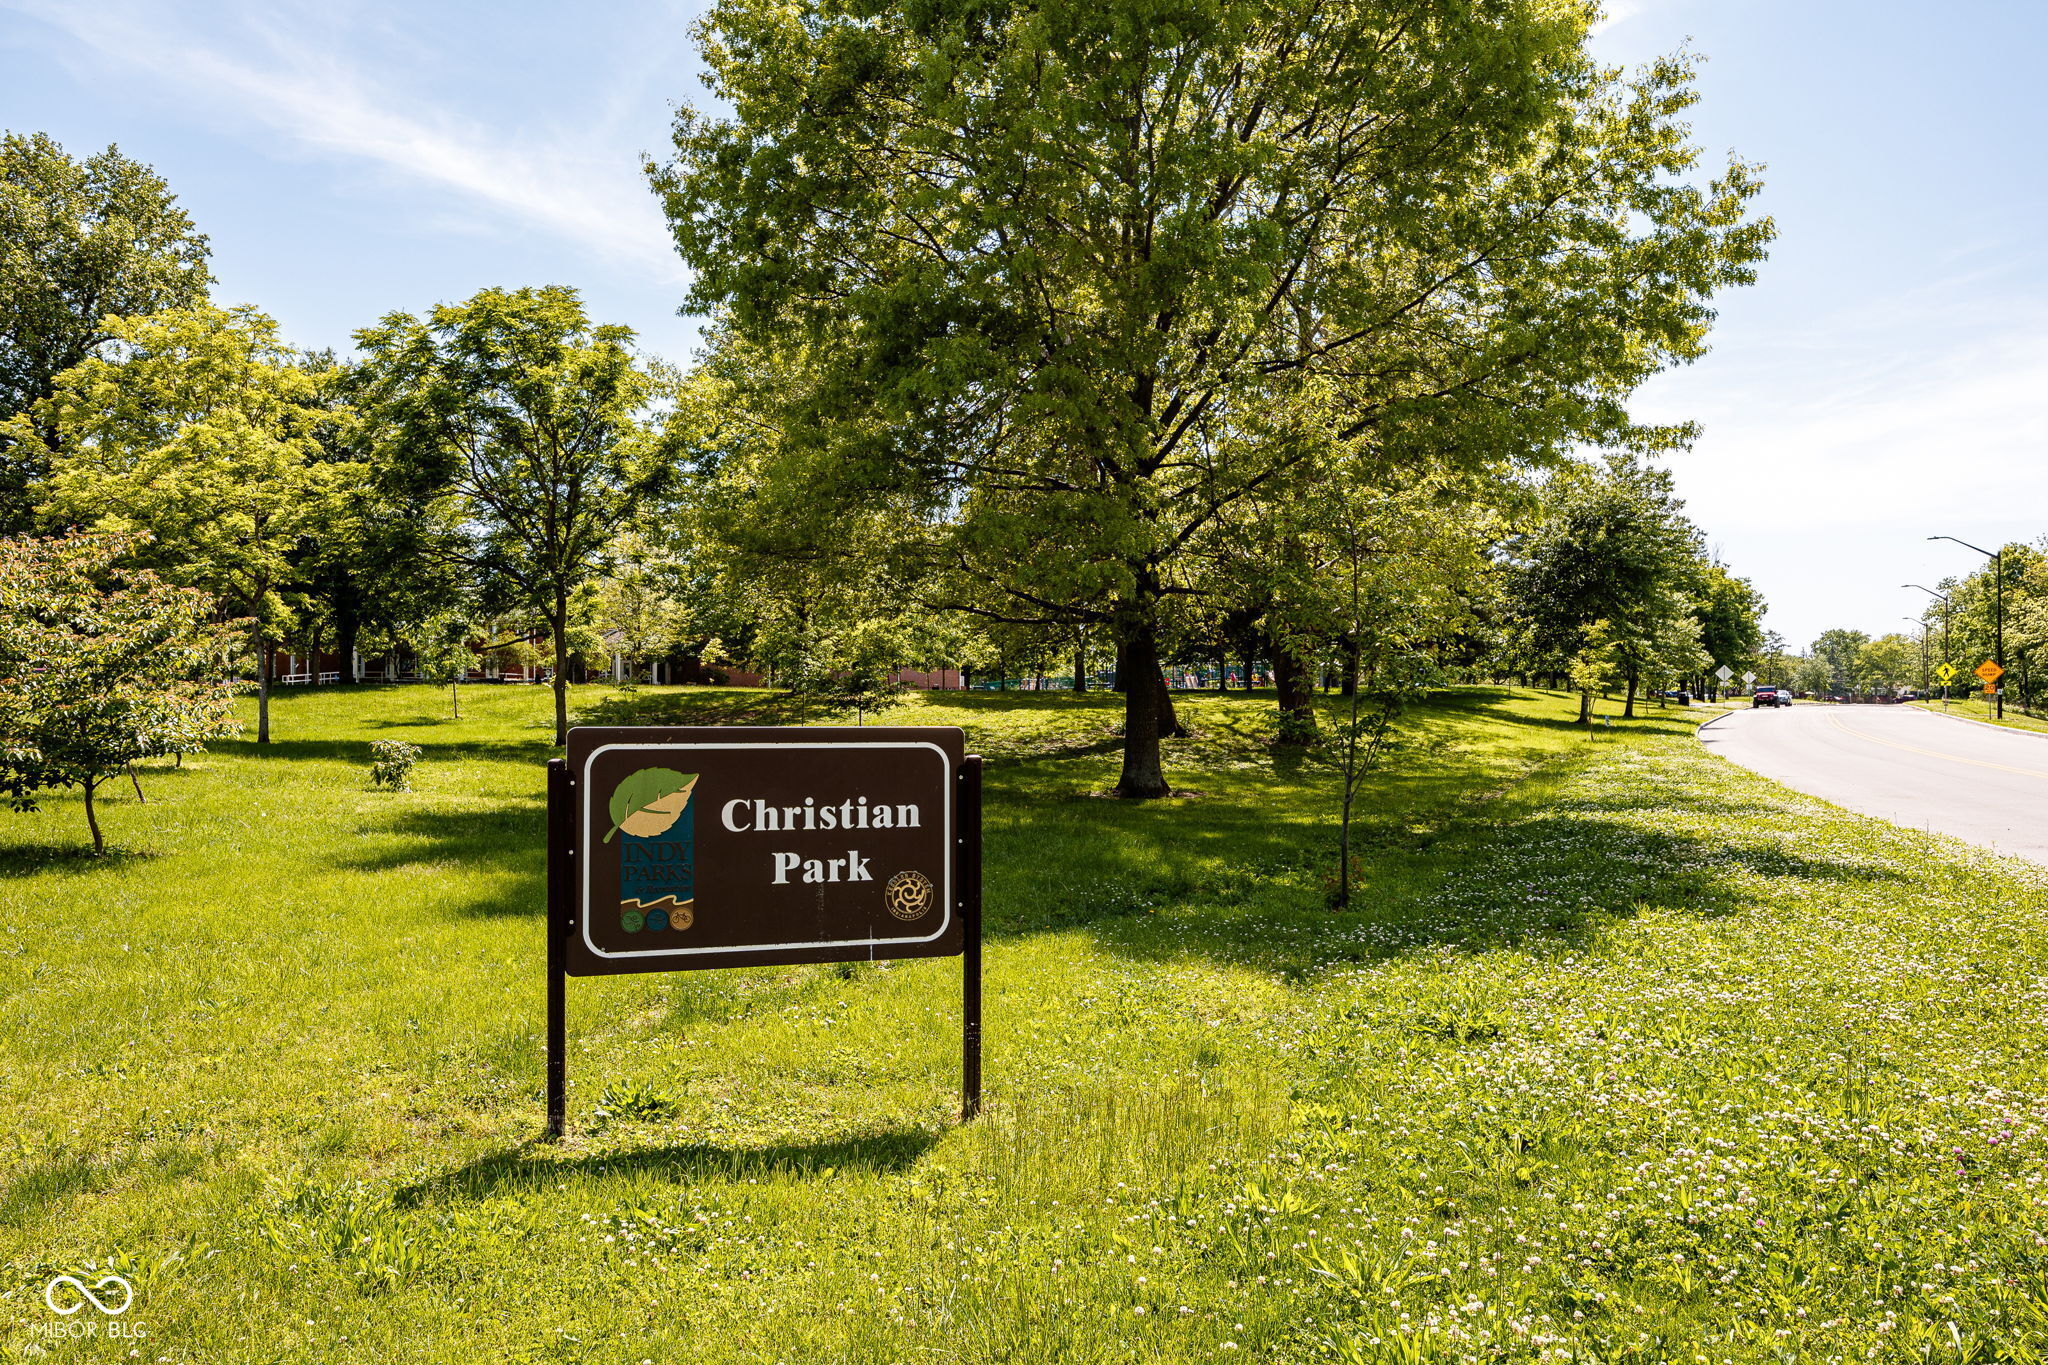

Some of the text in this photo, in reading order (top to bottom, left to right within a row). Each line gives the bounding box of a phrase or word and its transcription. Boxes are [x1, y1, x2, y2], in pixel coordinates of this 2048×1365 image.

[721, 796, 921, 832] Christian
[624, 841, 690, 863] INDY
[624, 863, 692, 882] PARKS
[771, 850, 874, 885] Park
